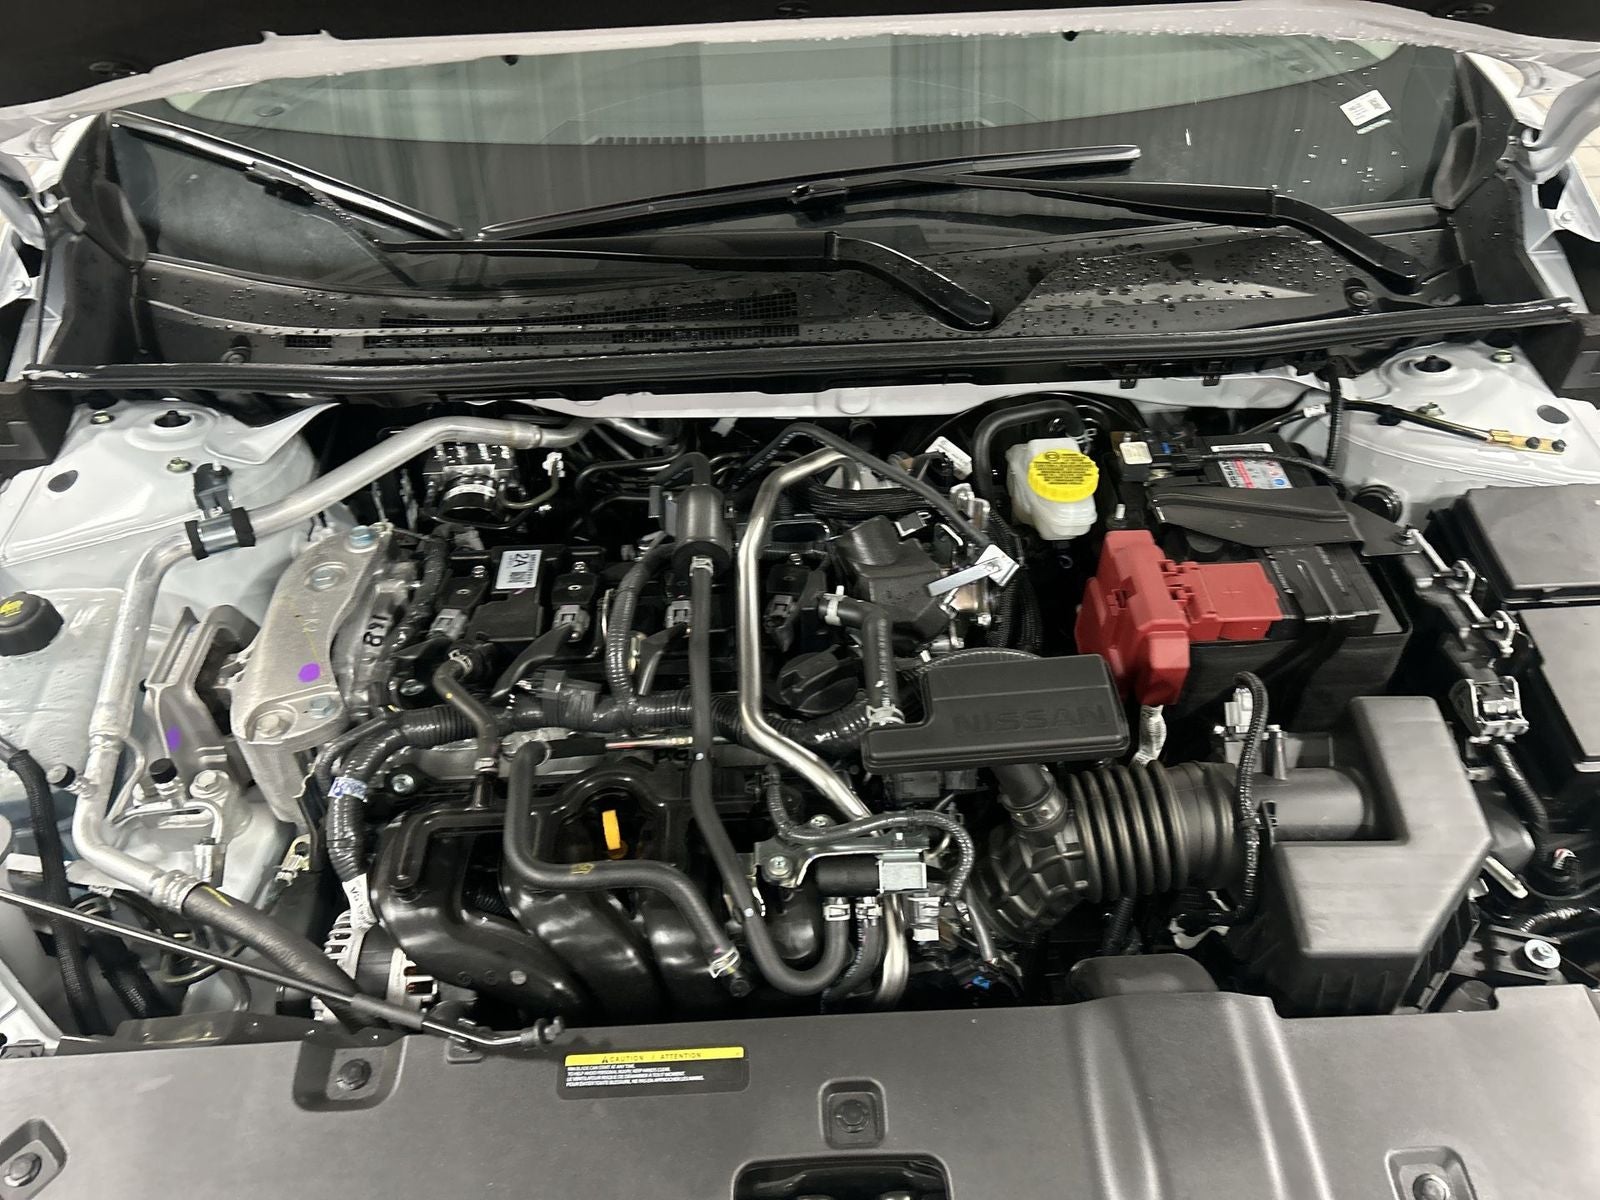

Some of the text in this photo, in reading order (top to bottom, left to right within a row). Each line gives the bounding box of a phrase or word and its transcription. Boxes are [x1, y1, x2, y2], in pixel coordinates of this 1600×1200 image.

[512, 553, 530, 568] 2A
[953, 704, 1108, 735] NISSAN
[609, 1055, 645, 1063] CAUTION
[660, 1052, 702, 1060] ATTENTION
